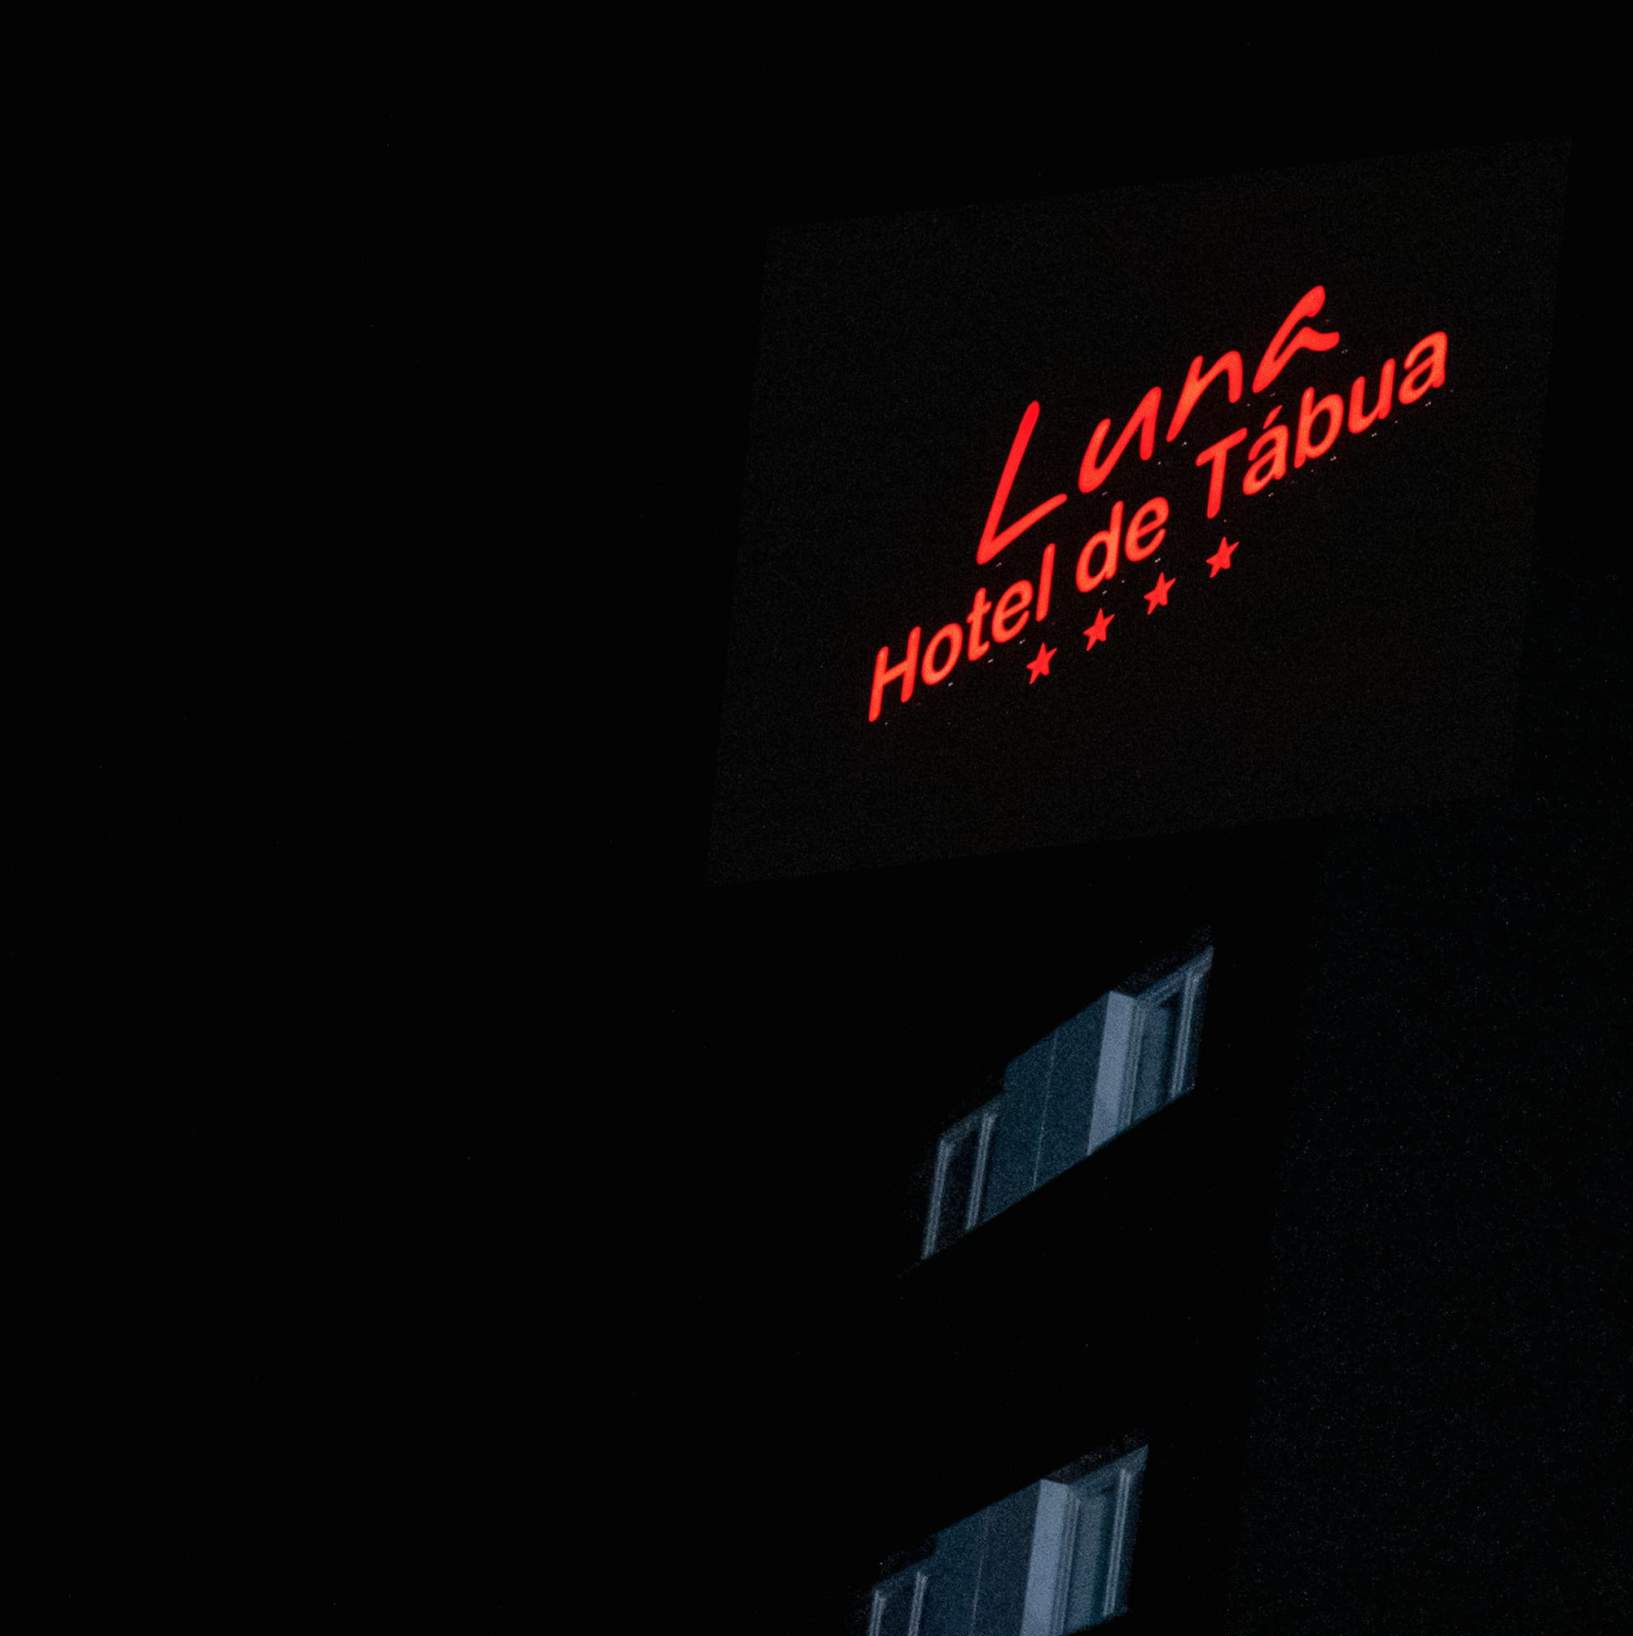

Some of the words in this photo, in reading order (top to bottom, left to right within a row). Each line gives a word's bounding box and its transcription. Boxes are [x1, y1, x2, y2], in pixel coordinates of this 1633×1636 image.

[869, 543, 1056, 722] Hotel
[1076, 497, 1169, 592] de
[1195, 331, 1448, 519] Tábua
[976, 285, 1340, 564] Luna
